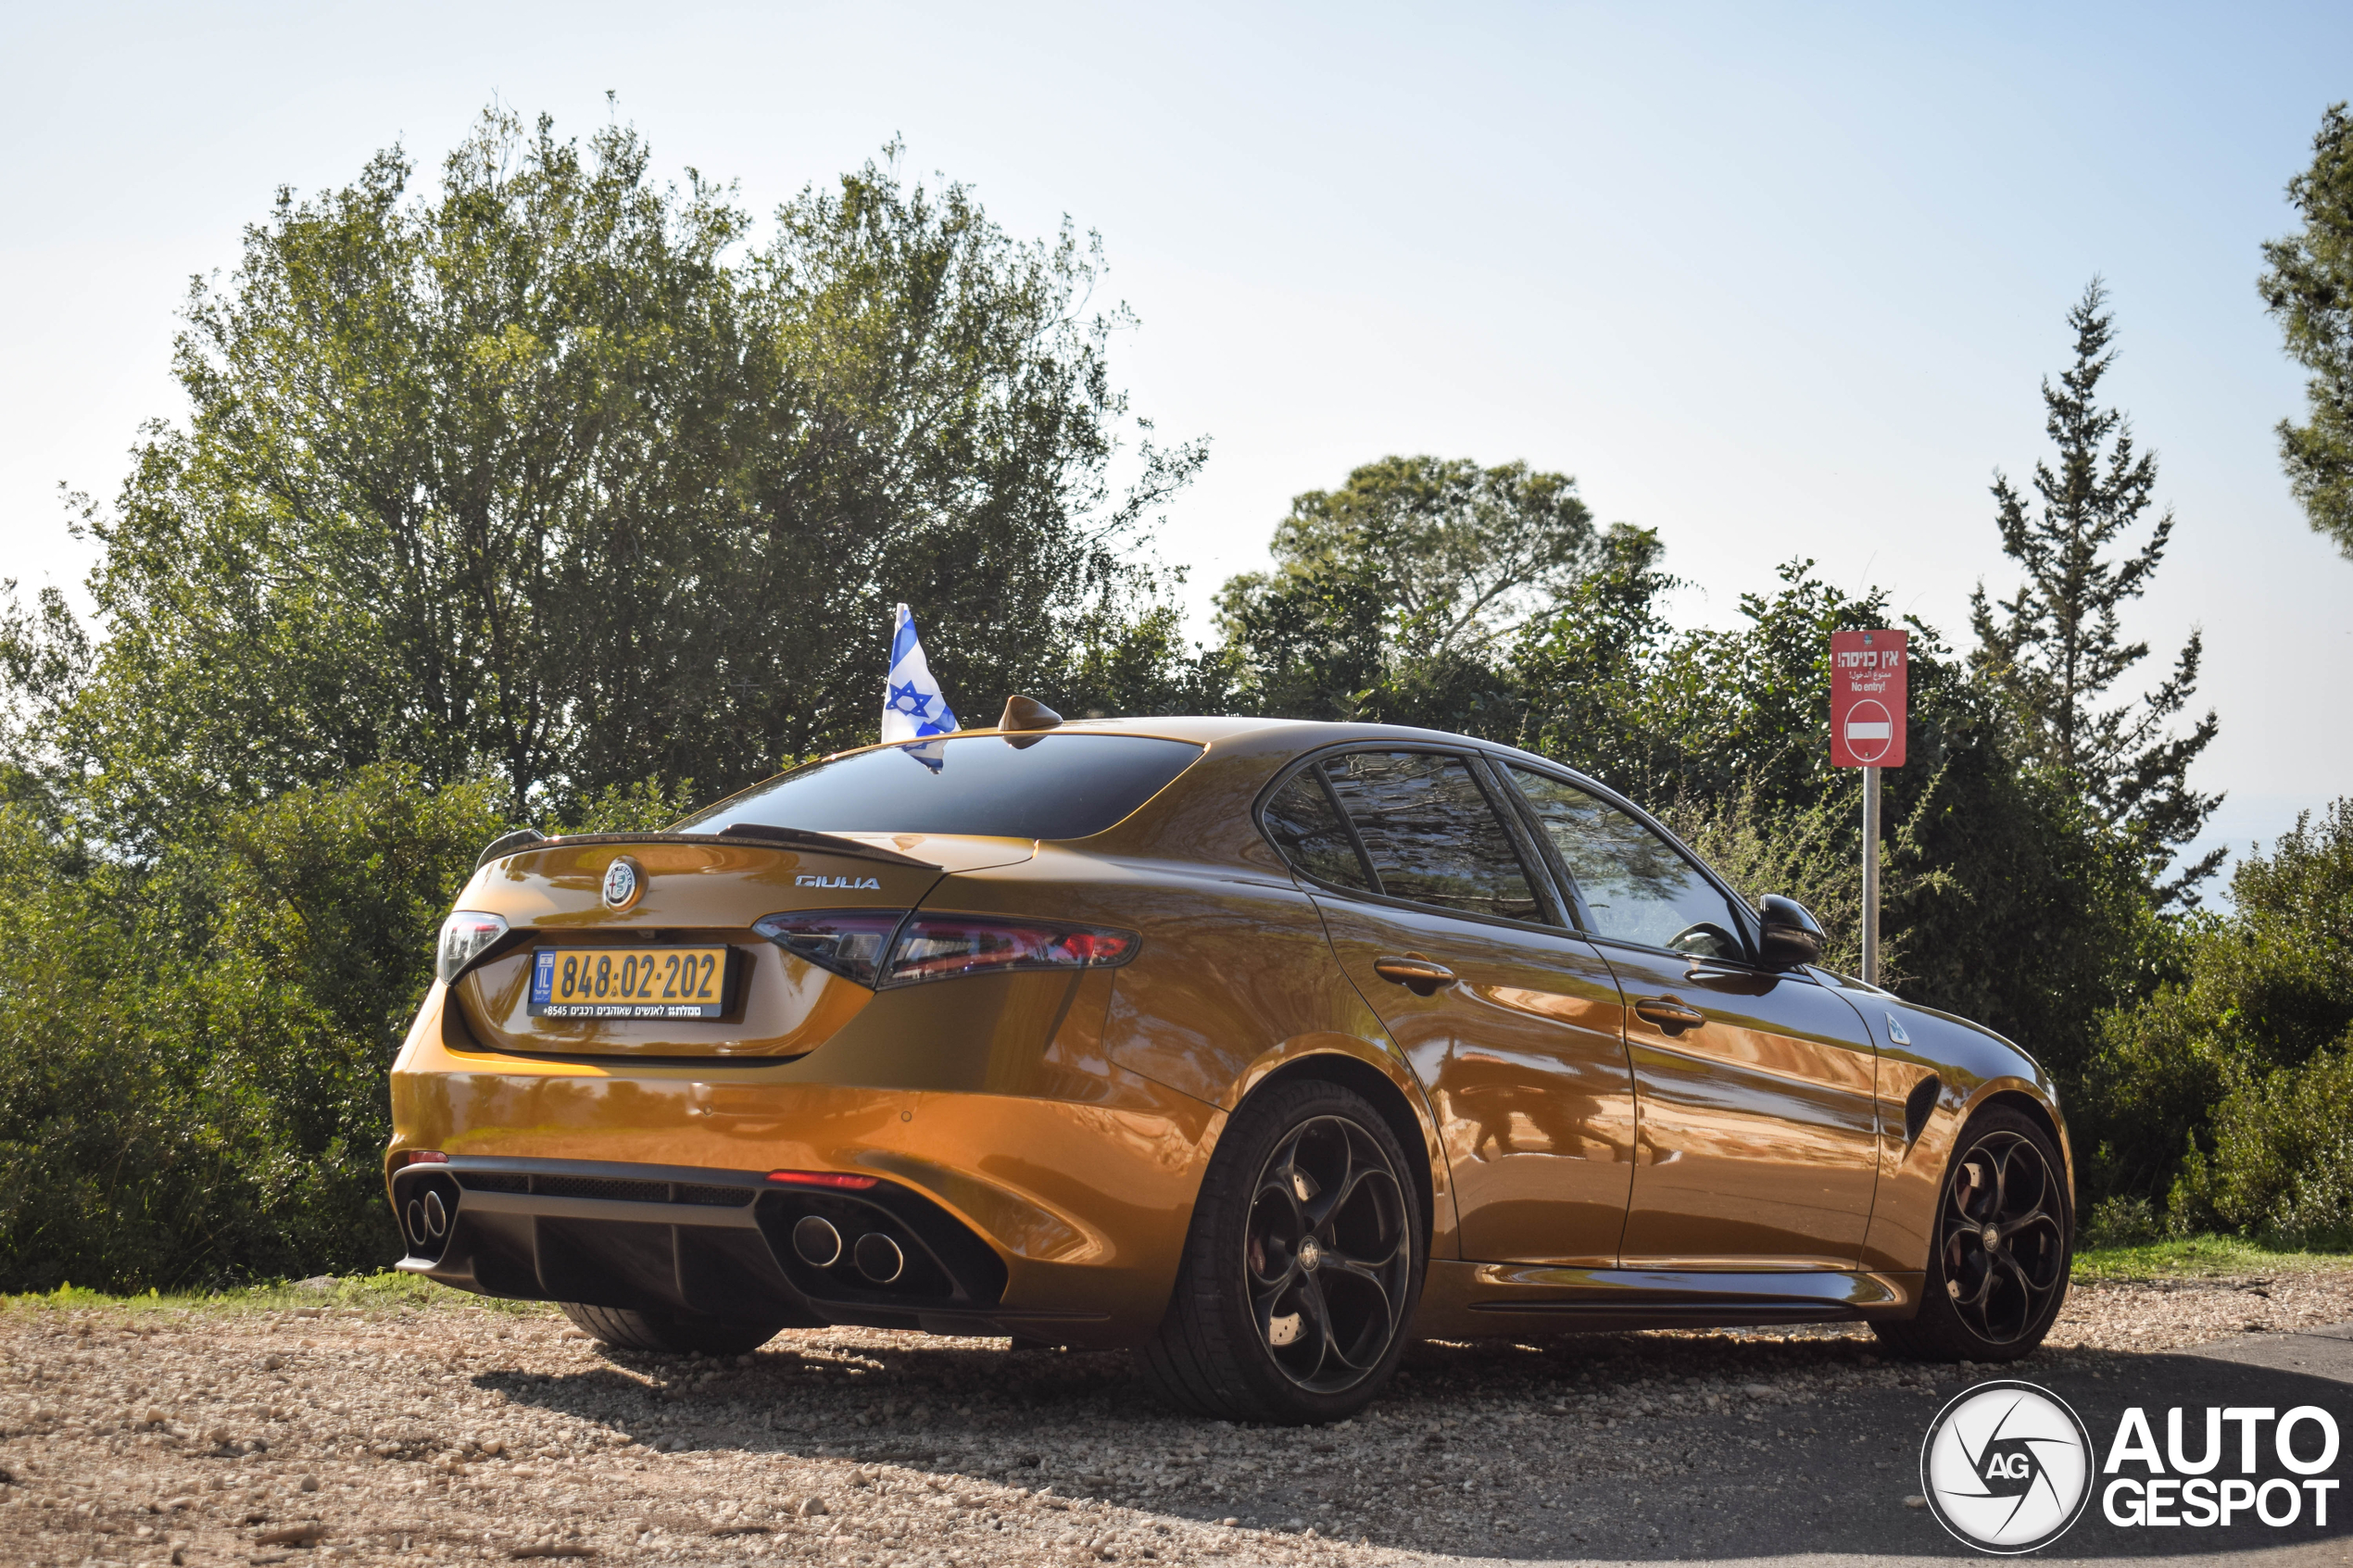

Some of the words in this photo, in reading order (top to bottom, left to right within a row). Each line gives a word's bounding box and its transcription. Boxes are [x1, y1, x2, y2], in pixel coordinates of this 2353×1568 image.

[1837, 651, 1878, 668] כניסה!
[1882, 650, 1899, 669] אין
[1851, 682, 1862, 691] No
[1864, 681, 1886, 693] entry!
[796, 875, 881, 889] GIULIA
[539, 968, 549, 988] IL
[570, 1006, 594, 1016] רכבים
[597, 1006, 632, 1016] שאוהבים
[635, 1005, 665, 1016] לאנשים
